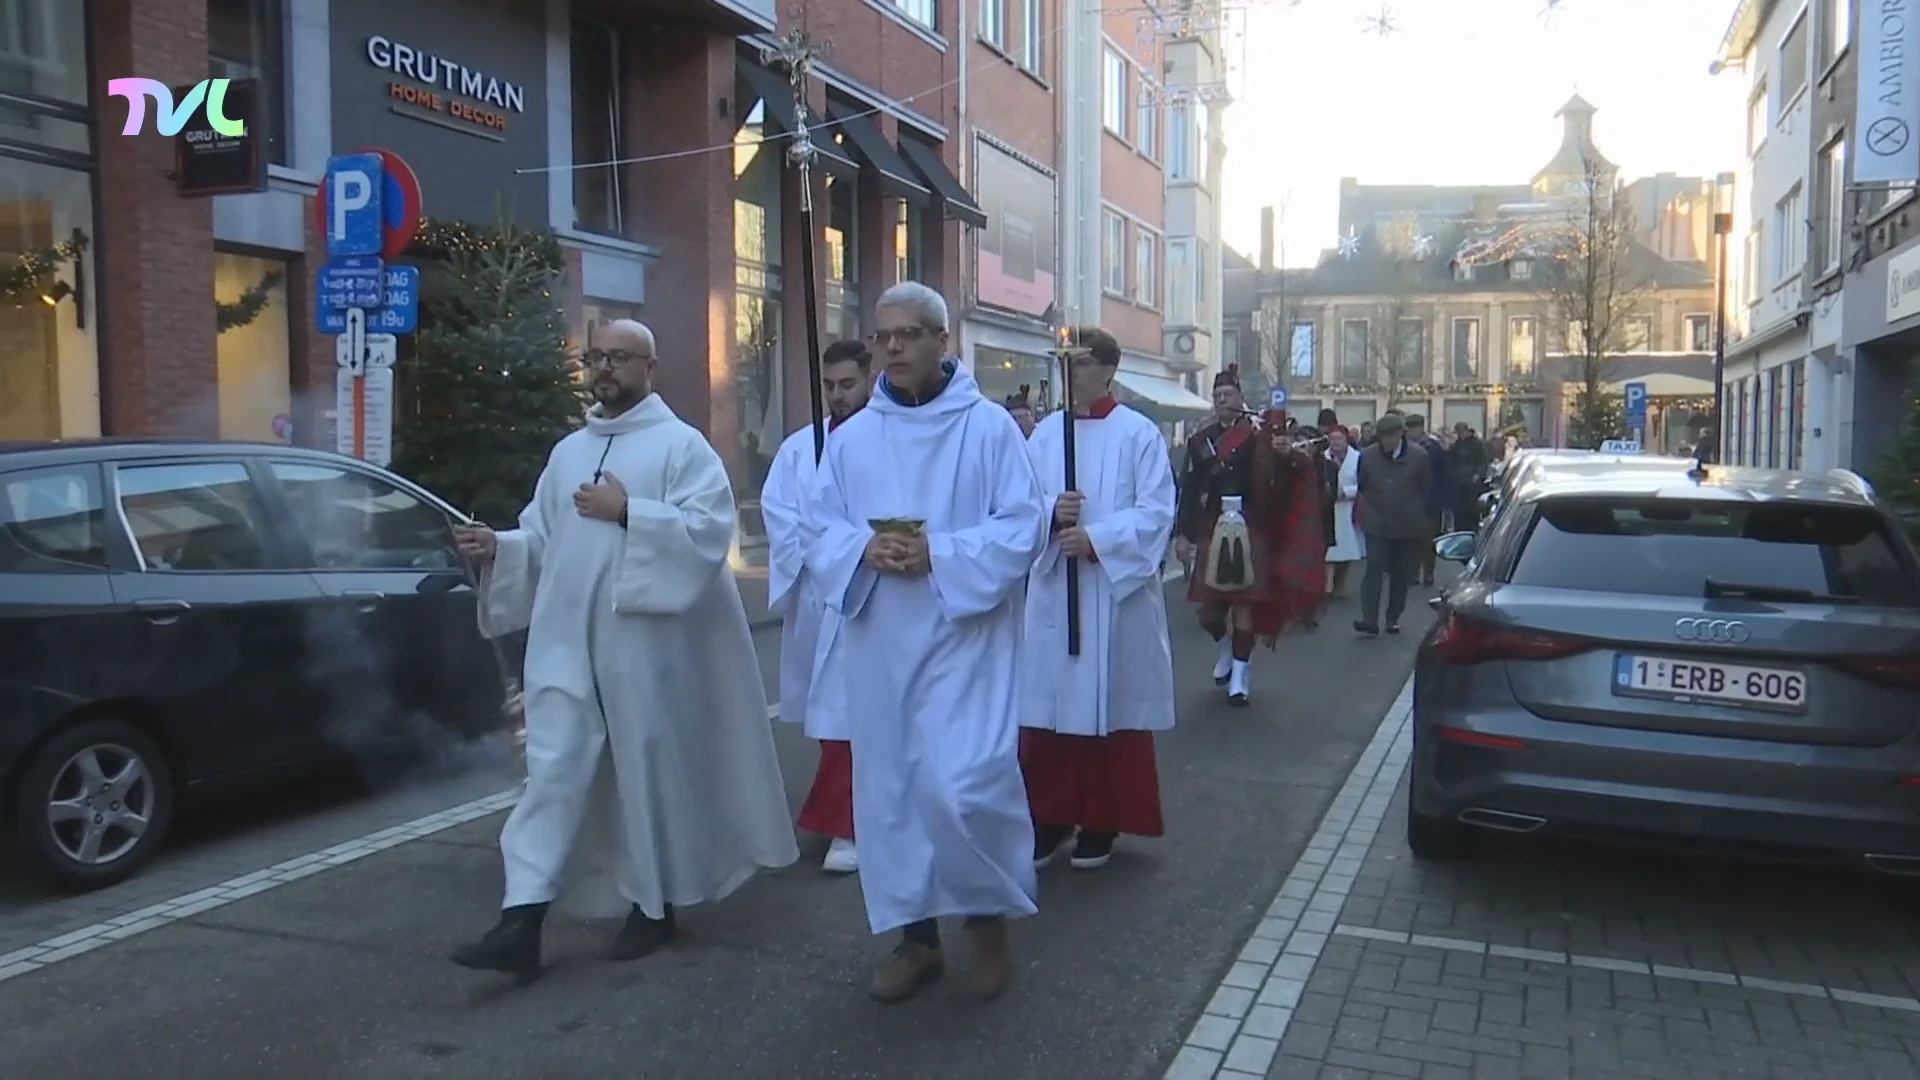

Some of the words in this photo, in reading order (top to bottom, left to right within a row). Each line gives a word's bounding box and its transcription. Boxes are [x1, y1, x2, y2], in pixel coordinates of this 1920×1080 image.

[367, 35, 524, 113] GRUTMAN
[390, 82, 442, 111] HOME
[450, 101, 506, 128] DECOR
[334, 170, 371, 240] P
[1272, 390, 1285, 408] P
[1627, 387, 1643, 409] P
[1607, 441, 1637, 451] TAXI
